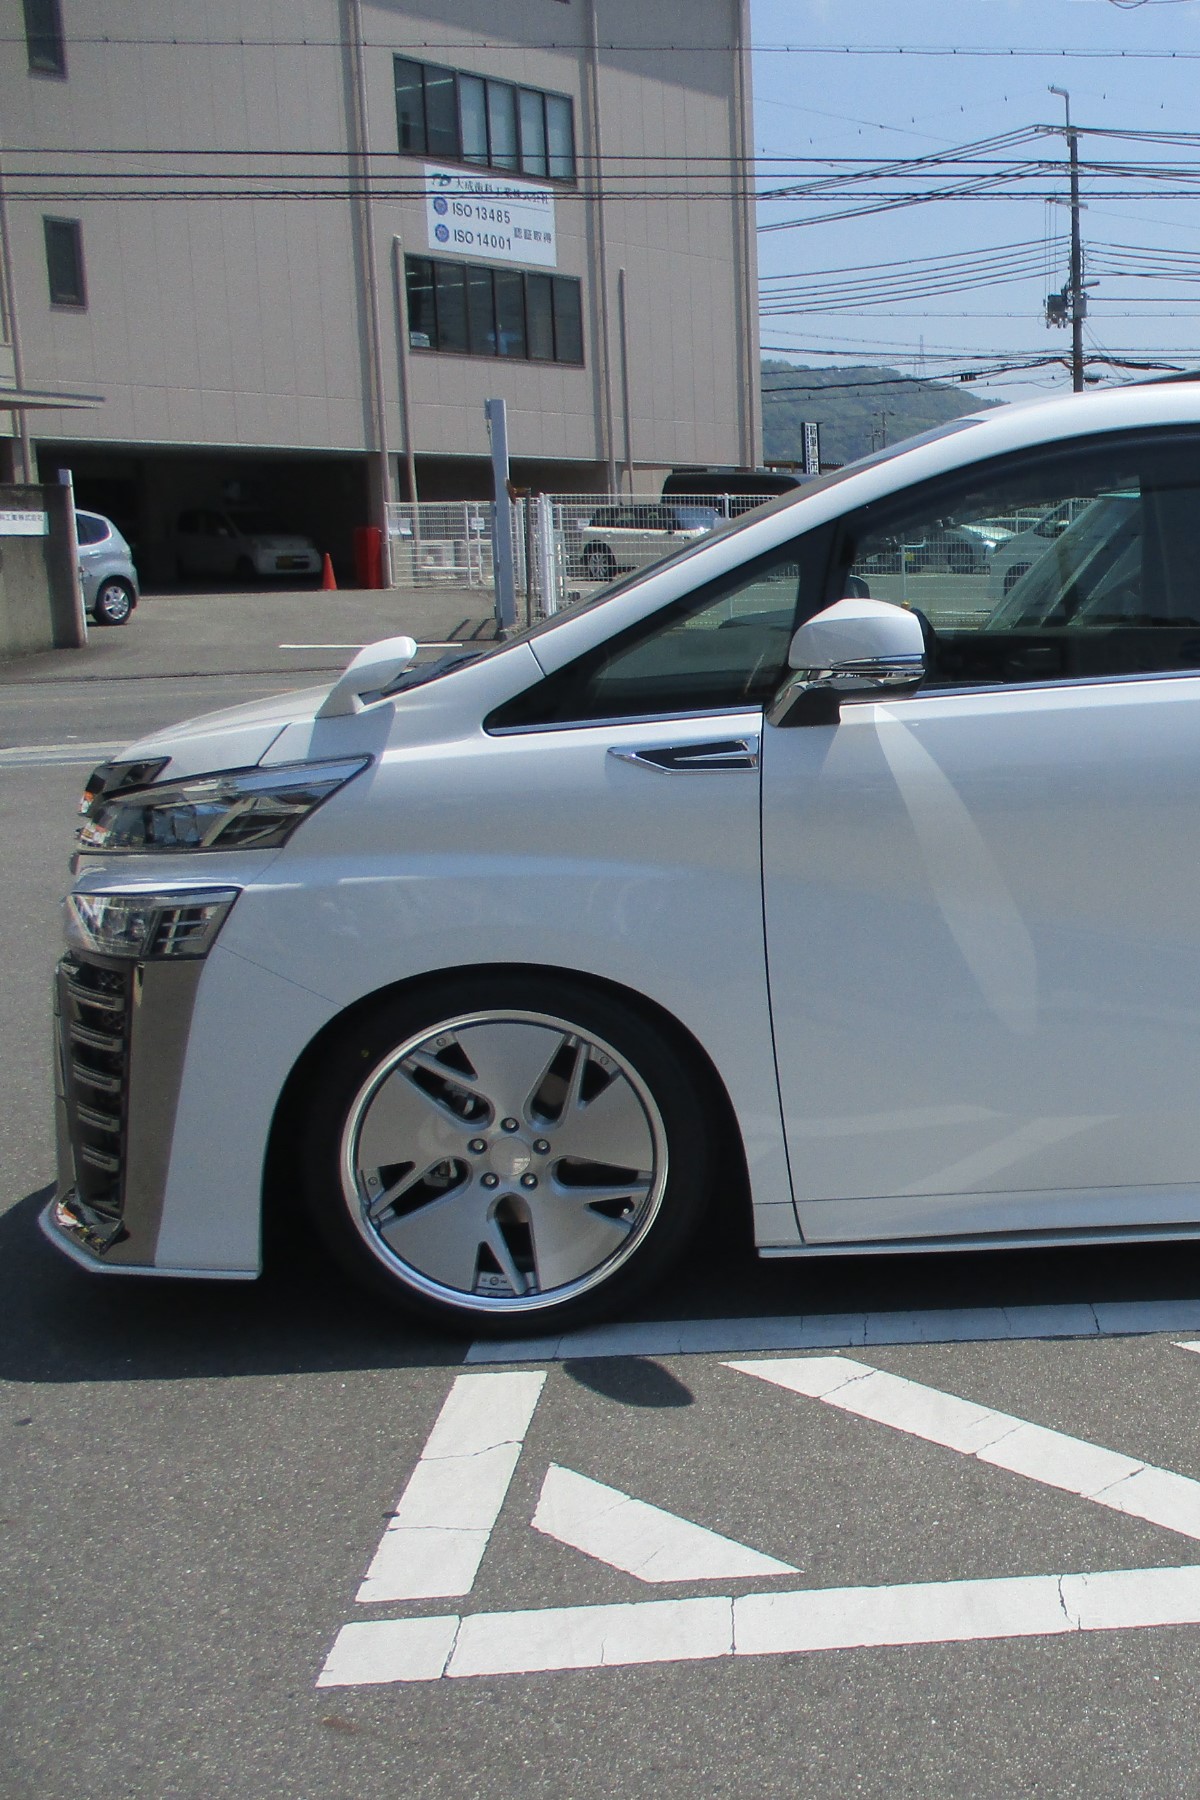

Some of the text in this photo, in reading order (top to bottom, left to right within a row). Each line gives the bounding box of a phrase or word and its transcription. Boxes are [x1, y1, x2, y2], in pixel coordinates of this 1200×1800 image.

[453, 202, 473, 218] ISO
[475, 206, 511, 224] 13485
[454, 229, 474, 245] ISO
[477, 233, 511, 250] 14001
[513, 226, 552, 244] 認証取得
